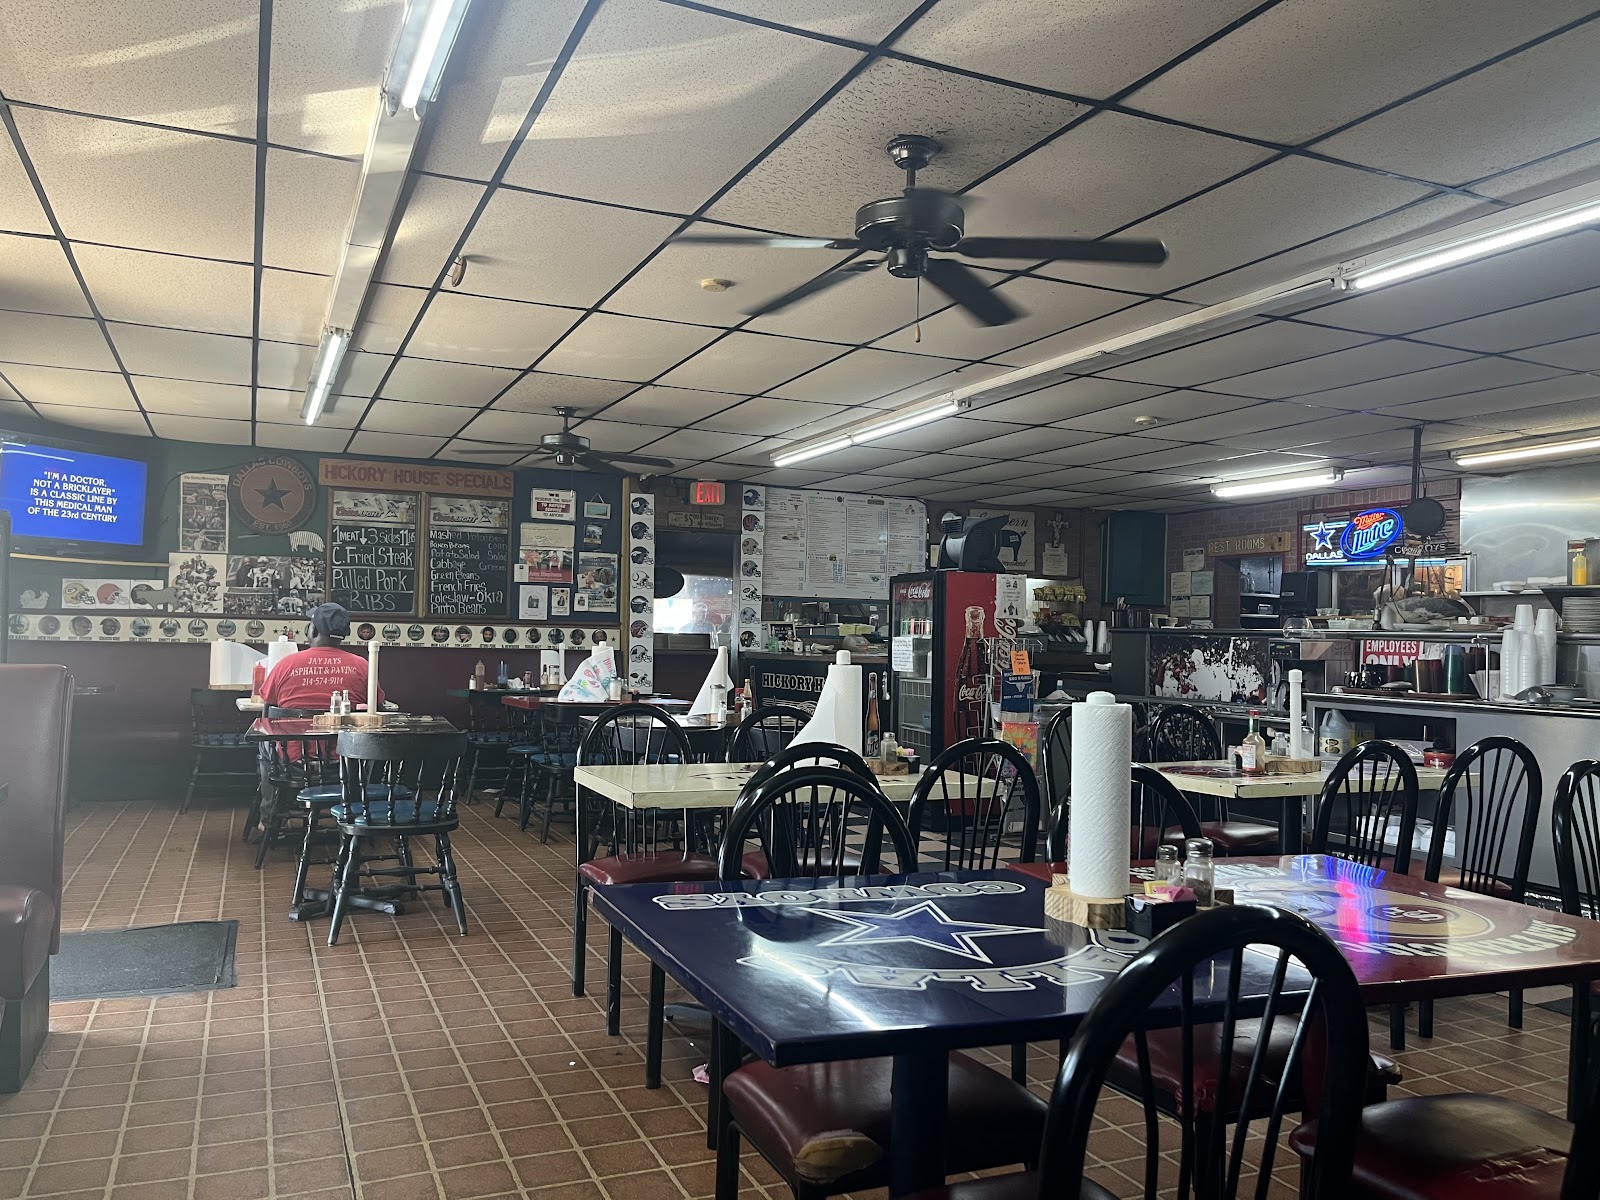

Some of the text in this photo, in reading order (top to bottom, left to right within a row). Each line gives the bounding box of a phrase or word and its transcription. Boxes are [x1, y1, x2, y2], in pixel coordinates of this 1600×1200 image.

[233, 456, 312, 491] DALLAS COWBOYS
[324, 464, 512, 491] HICKORY HOUSE SPECIALS
[33, 479, 52, 488] NOT
[54, 482, 60, 490] A
[30, 488, 39, 496] IS
[50, 491, 85, 502] CLASSIC
[87, 495, 104, 503] LINE
[107, 497, 118, 505] BY
[696, 483, 721, 503] EXIT
[34, 498, 113, 513] THIS MEDICAL MAN
[28, 507, 118, 522] OF THE 23rd CENTURY
[700, 514, 720, 524] harge
[1354, 512, 1385, 529] Miller
[340, 531, 360, 541] MEAT
[367, 528, 378, 544] 3
[430, 530, 462, 540] Mashed
[1351, 519, 1394, 554] Lite
[448, 541, 470, 549] Beans
[1209, 538, 1265, 553] REST ROOMS
[1394, 543, 1446, 554] COYS
[345, 546, 376, 566] Fried
[378, 547, 413, 567] Steak
[431, 548, 459, 559] Potato
[1305, 550, 1344, 560] DALLAS
[430, 558, 466, 572] Cabbage
[333, 569, 408, 591] Pulled Pork
[430, 570, 480, 581] Green Beans
[431, 580, 487, 592] French Fries
[908, 582, 931, 598] Coca-Cola
[350, 590, 396, 611] RIBS
[431, 603, 486, 615] Pinto Beans
[1366, 640, 1417, 653] EMPLOYEES
[290, 666, 357, 677] ASPHALT & PAVING
[762, 673, 813, 692] HICKORY
[652, 880, 1027, 911] COWBOYS
[1522, 919, 1578, 944] SAN
[736, 927, 1150, 993] DALLAS
